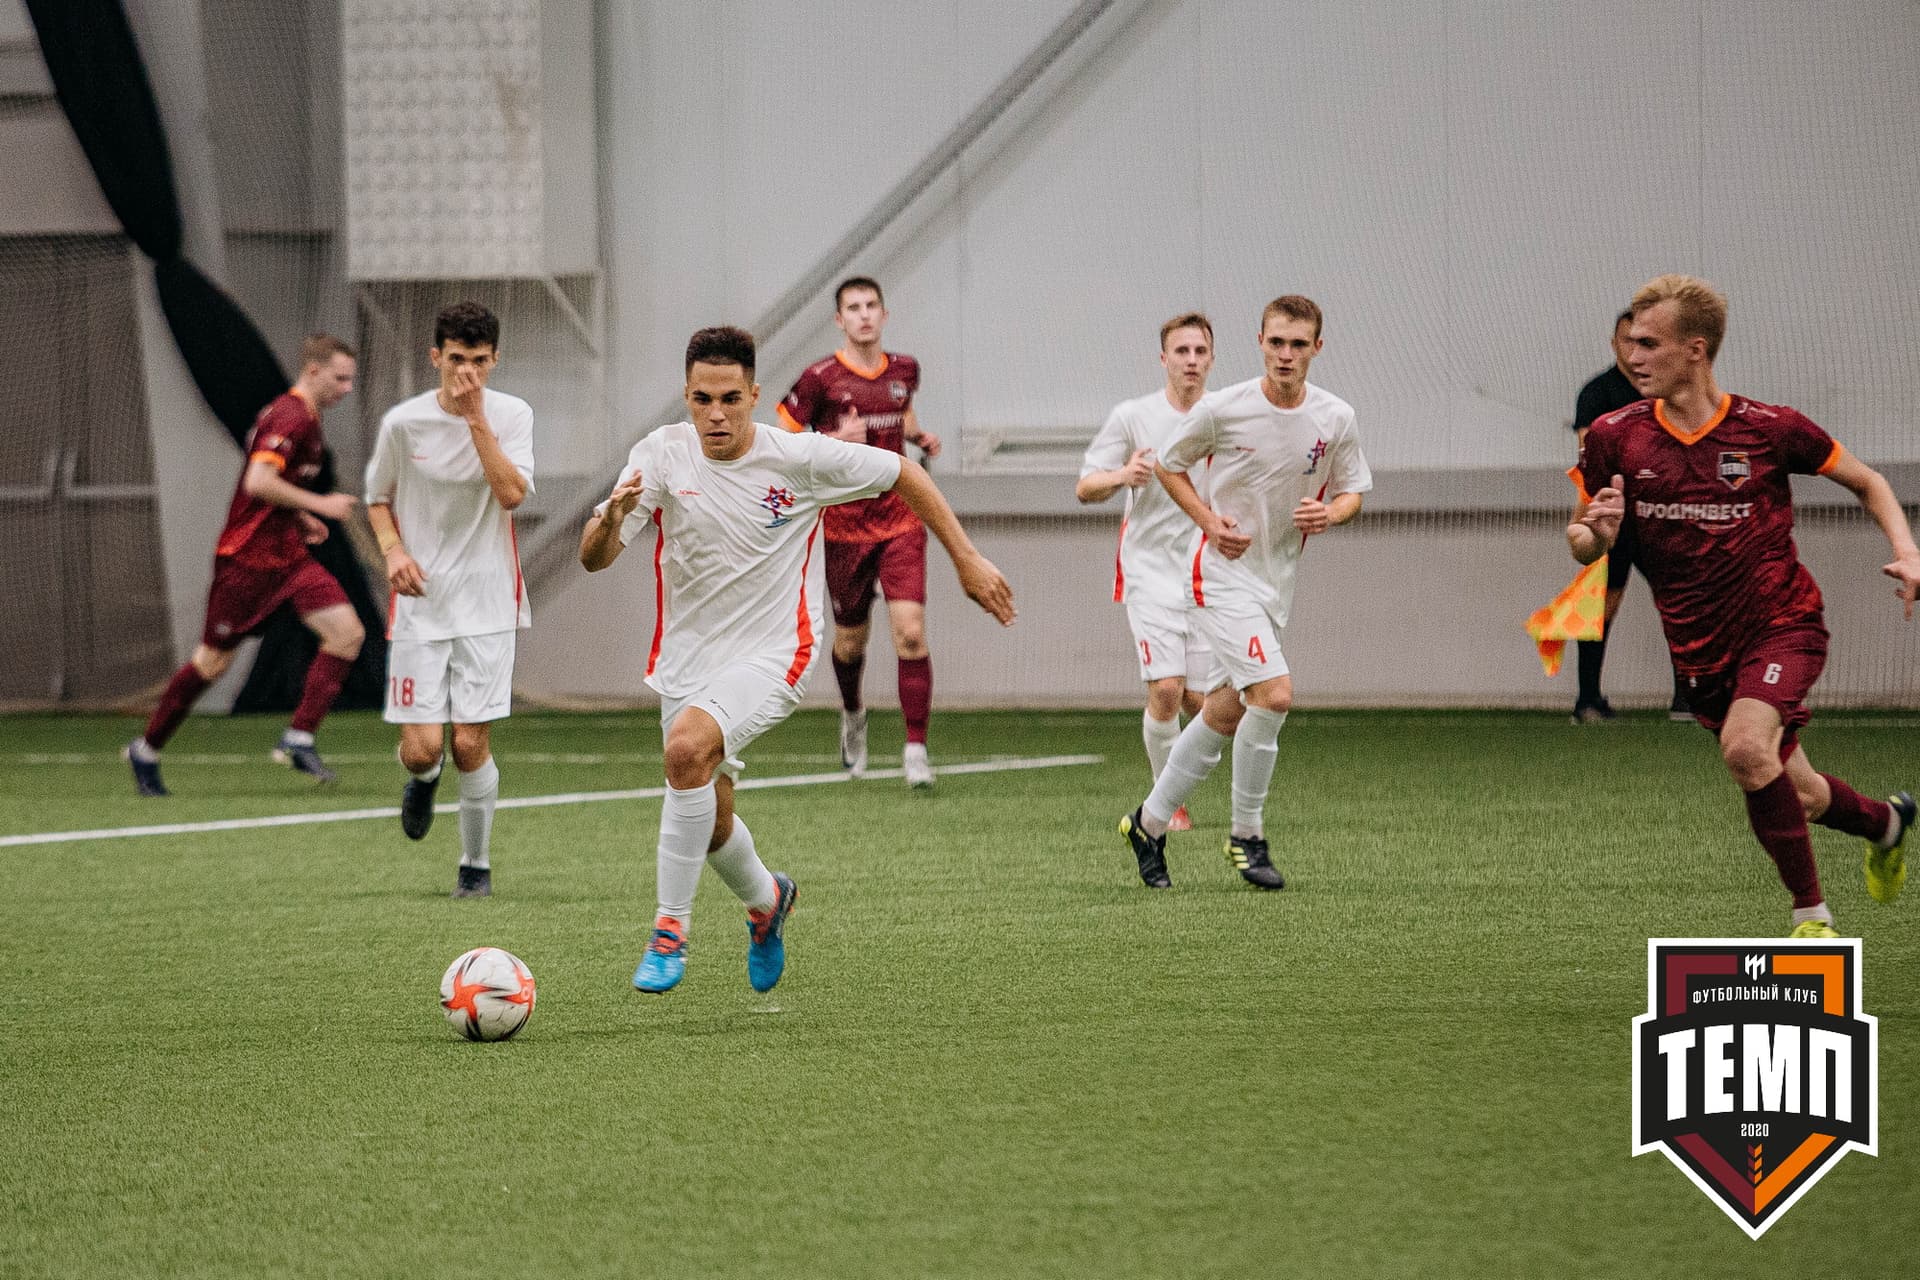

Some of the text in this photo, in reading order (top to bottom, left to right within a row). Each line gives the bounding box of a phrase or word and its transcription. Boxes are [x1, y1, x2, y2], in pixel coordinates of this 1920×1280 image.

[1248, 635, 1267, 664] 4
[1762, 663, 1783, 684] 6
[391, 676, 415, 707] 18
